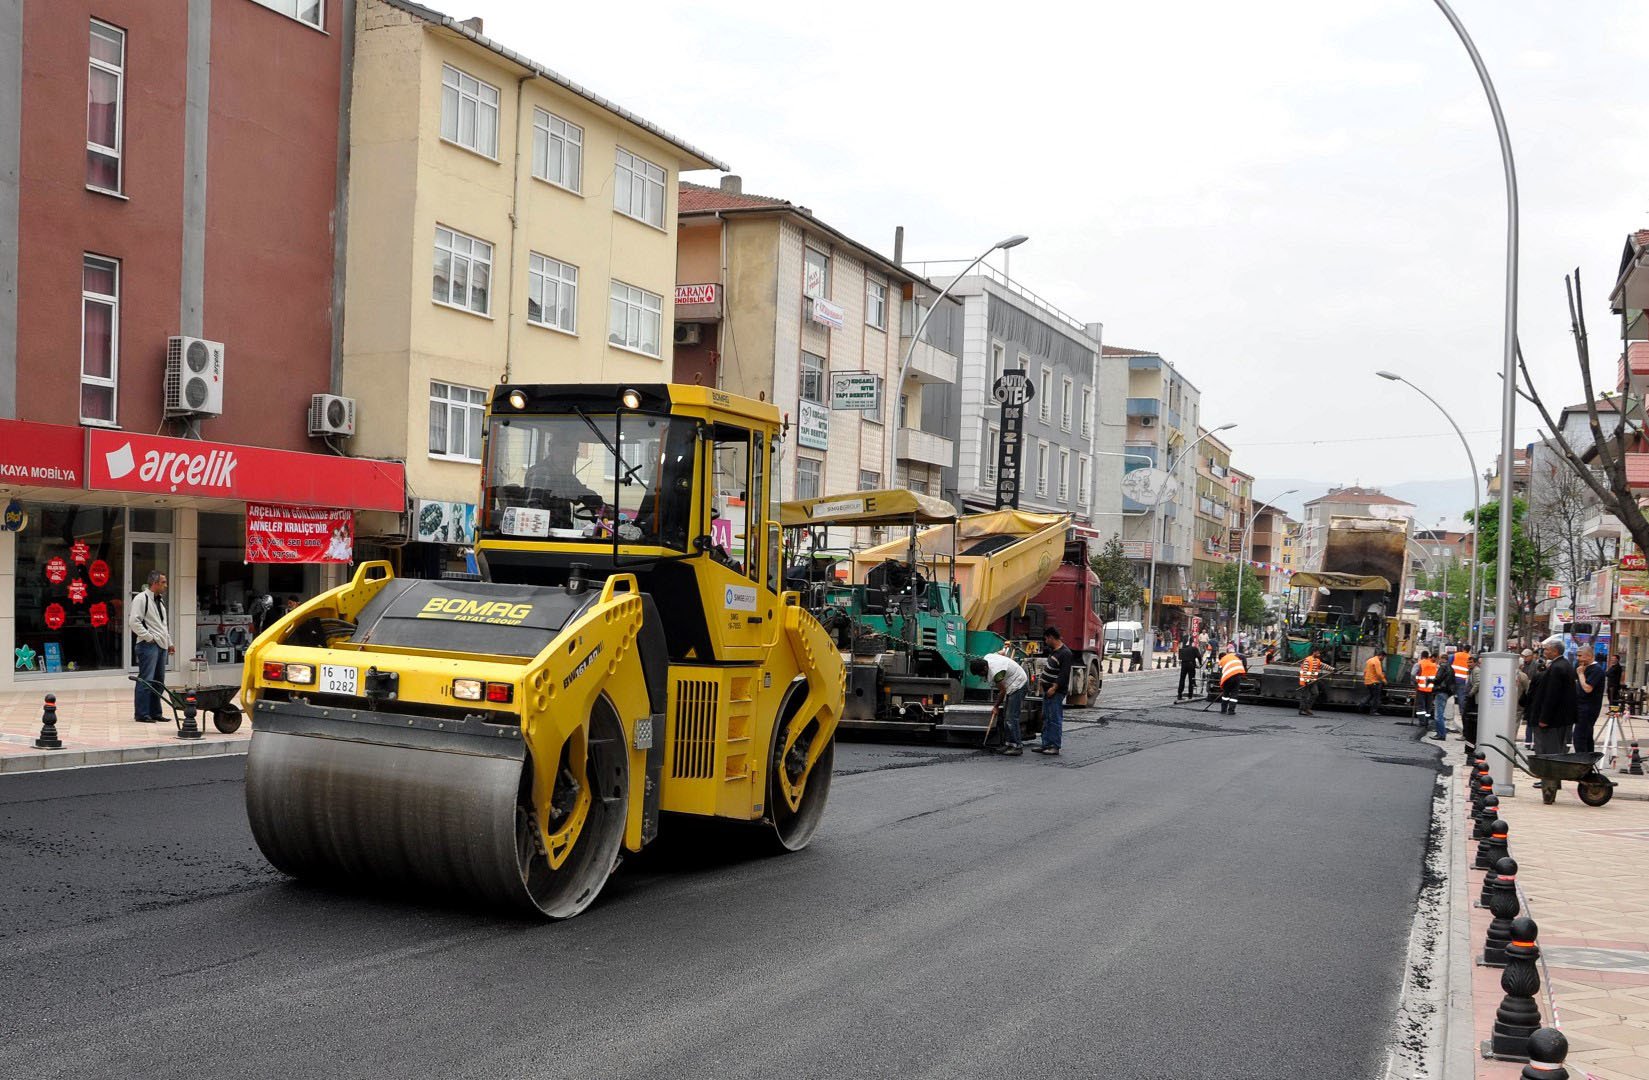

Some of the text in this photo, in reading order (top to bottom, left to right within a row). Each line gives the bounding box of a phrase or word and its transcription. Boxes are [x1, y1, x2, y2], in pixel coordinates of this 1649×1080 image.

[675, 285, 704, 297] TARAN
[995, 386, 1029, 405] OTEL
[0, 464, 76, 481] KAYA MOBİLYA
[139, 449, 238, 493] arçelik
[250, 521, 282, 532] ANNELER
[287, 538, 301, 546] sen
[421, 597, 534, 620] BOMAG
[454, 614, 522, 626] FAYAT GROUP
[323, 666, 355, 680] 16 10
[329, 680, 354, 693] 0282
